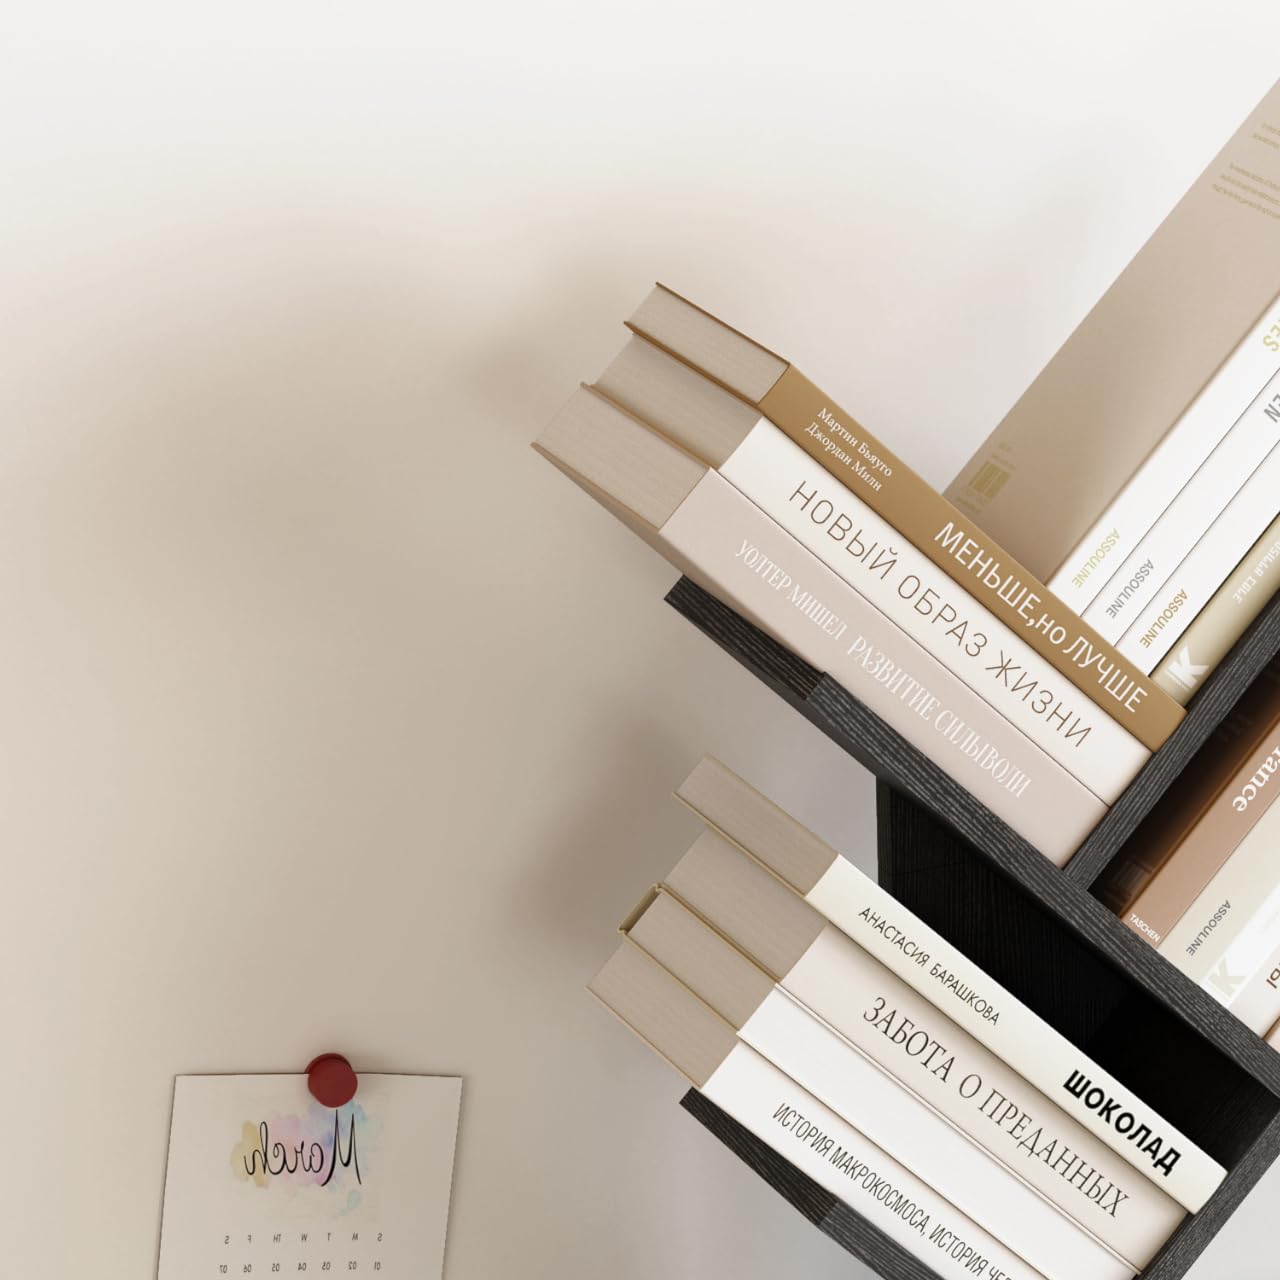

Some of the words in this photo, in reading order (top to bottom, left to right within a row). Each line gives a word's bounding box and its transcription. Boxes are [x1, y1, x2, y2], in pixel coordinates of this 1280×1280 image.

[804, 422, 851, 465] Джордан
[851, 460, 882, 492] Милн
[817, 408, 859, 447] Мартин
[857, 443, 893, 478] Бьяуго
[1071, 528, 1121, 588] ASSOULINE
[1105, 557, 1155, 618] ASSOULINE
[735, 539, 792, 596] УОЛТЕР
[789, 587, 848, 640] МИШЕЛ
[847, 636, 941, 721] РАЗВИТИЕ
[789, 480, 898, 580] НОВЫЙ
[897, 574, 988, 657] ОБРАЗ
[985, 649, 1093, 748] ЖИЗНИ
[1140, 588, 1188, 649] ASSOULINE
[1062, 641, 1149, 713] ЛУЧШЕ
[1129, 912, 1161, 943] TASCHEN
[1186, 899, 1231, 956] ASSOULINE
[858, 907, 930, 967] АНАСТАСИЯ
[929, 962, 1000, 1026] БАРАШКОВА
[863, 996, 960, 1083] ЗАБОТА
[959, 1073, 983, 1099] О
[978, 1087, 1131, 1218] ПРЕДАННЫХ
[1062, 1069, 1182, 1177] ШОКОЛАД
[772, 1102, 835, 1157] ИСТОРИЯ
[828, 1141, 930, 1237] МАКРОКОСМОСА,
[928, 1222, 990, 1276] ИСТОРИЯ
